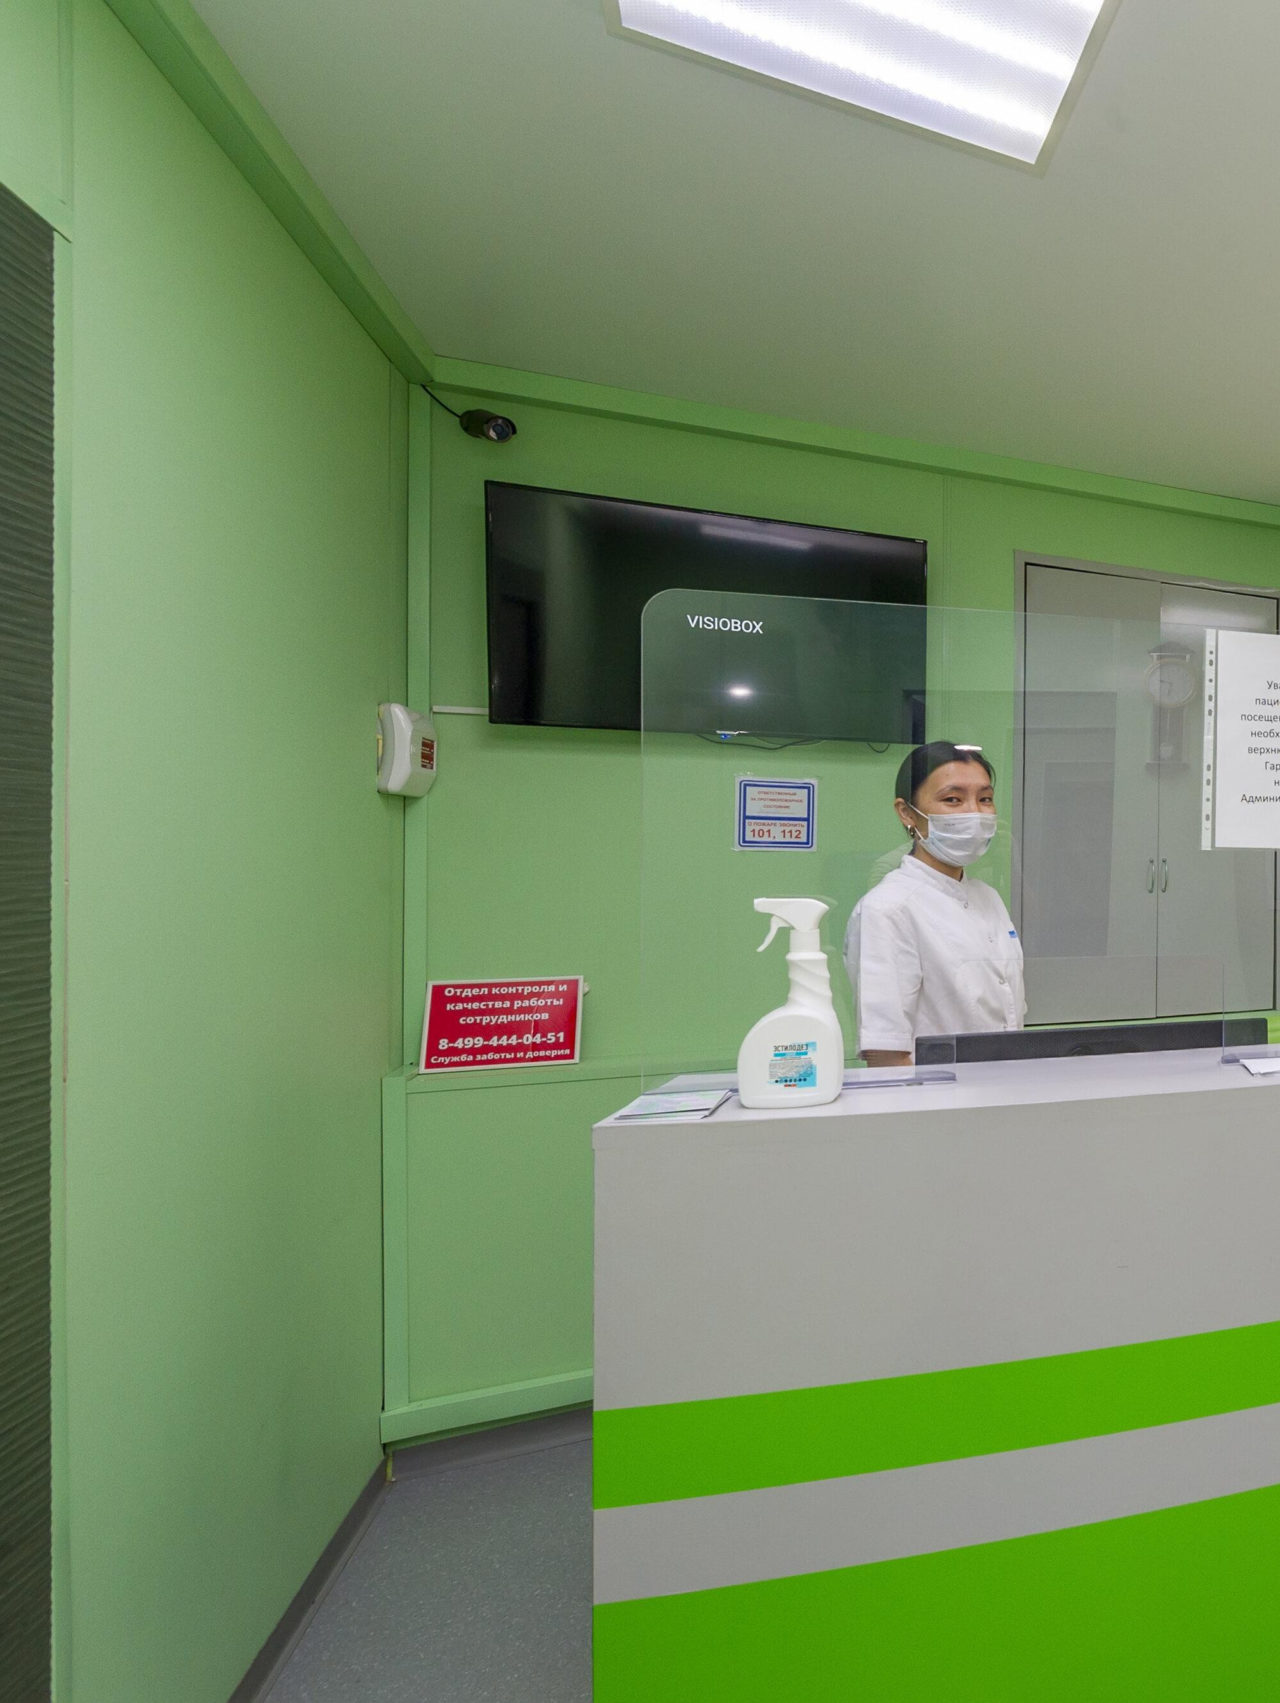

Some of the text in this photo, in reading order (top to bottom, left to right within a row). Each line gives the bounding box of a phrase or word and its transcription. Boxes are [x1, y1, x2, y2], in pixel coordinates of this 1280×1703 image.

[686, 614, 764, 634] VISIOBOX
[750, 828, 802, 839] 101, 112
[444, 984, 568, 997] Отдел контроля и
[446, 998, 564, 1011] качества работы
[459, 1012, 549, 1026] сотрудников
[438, 1032, 565, 1050] 8-499-444-04-51
[430, 1048, 570, 1064] Служба заботы и доверия
